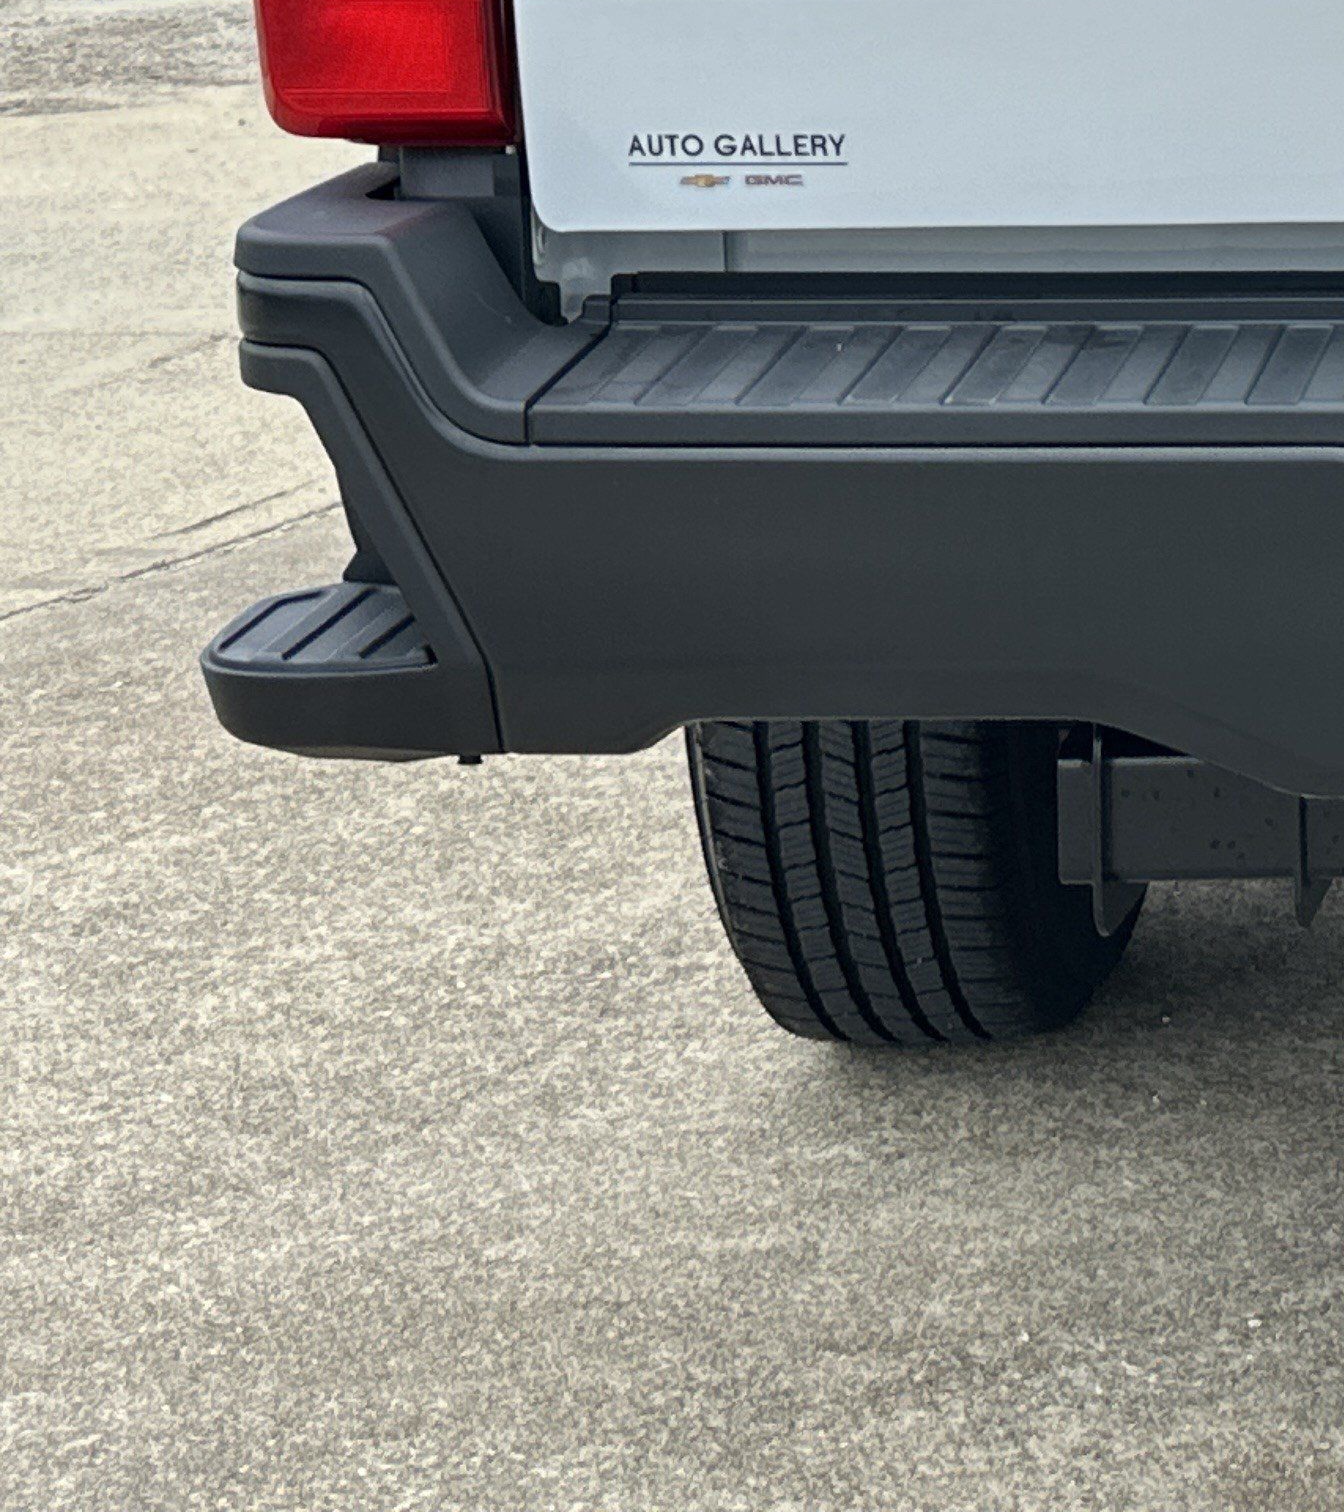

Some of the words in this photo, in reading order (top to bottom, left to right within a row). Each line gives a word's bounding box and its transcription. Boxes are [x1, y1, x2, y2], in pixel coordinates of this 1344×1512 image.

[628, 133, 704, 157] AUTO
[714, 133, 846, 157] GALLERY
[744, 174, 804, 186] GMC
